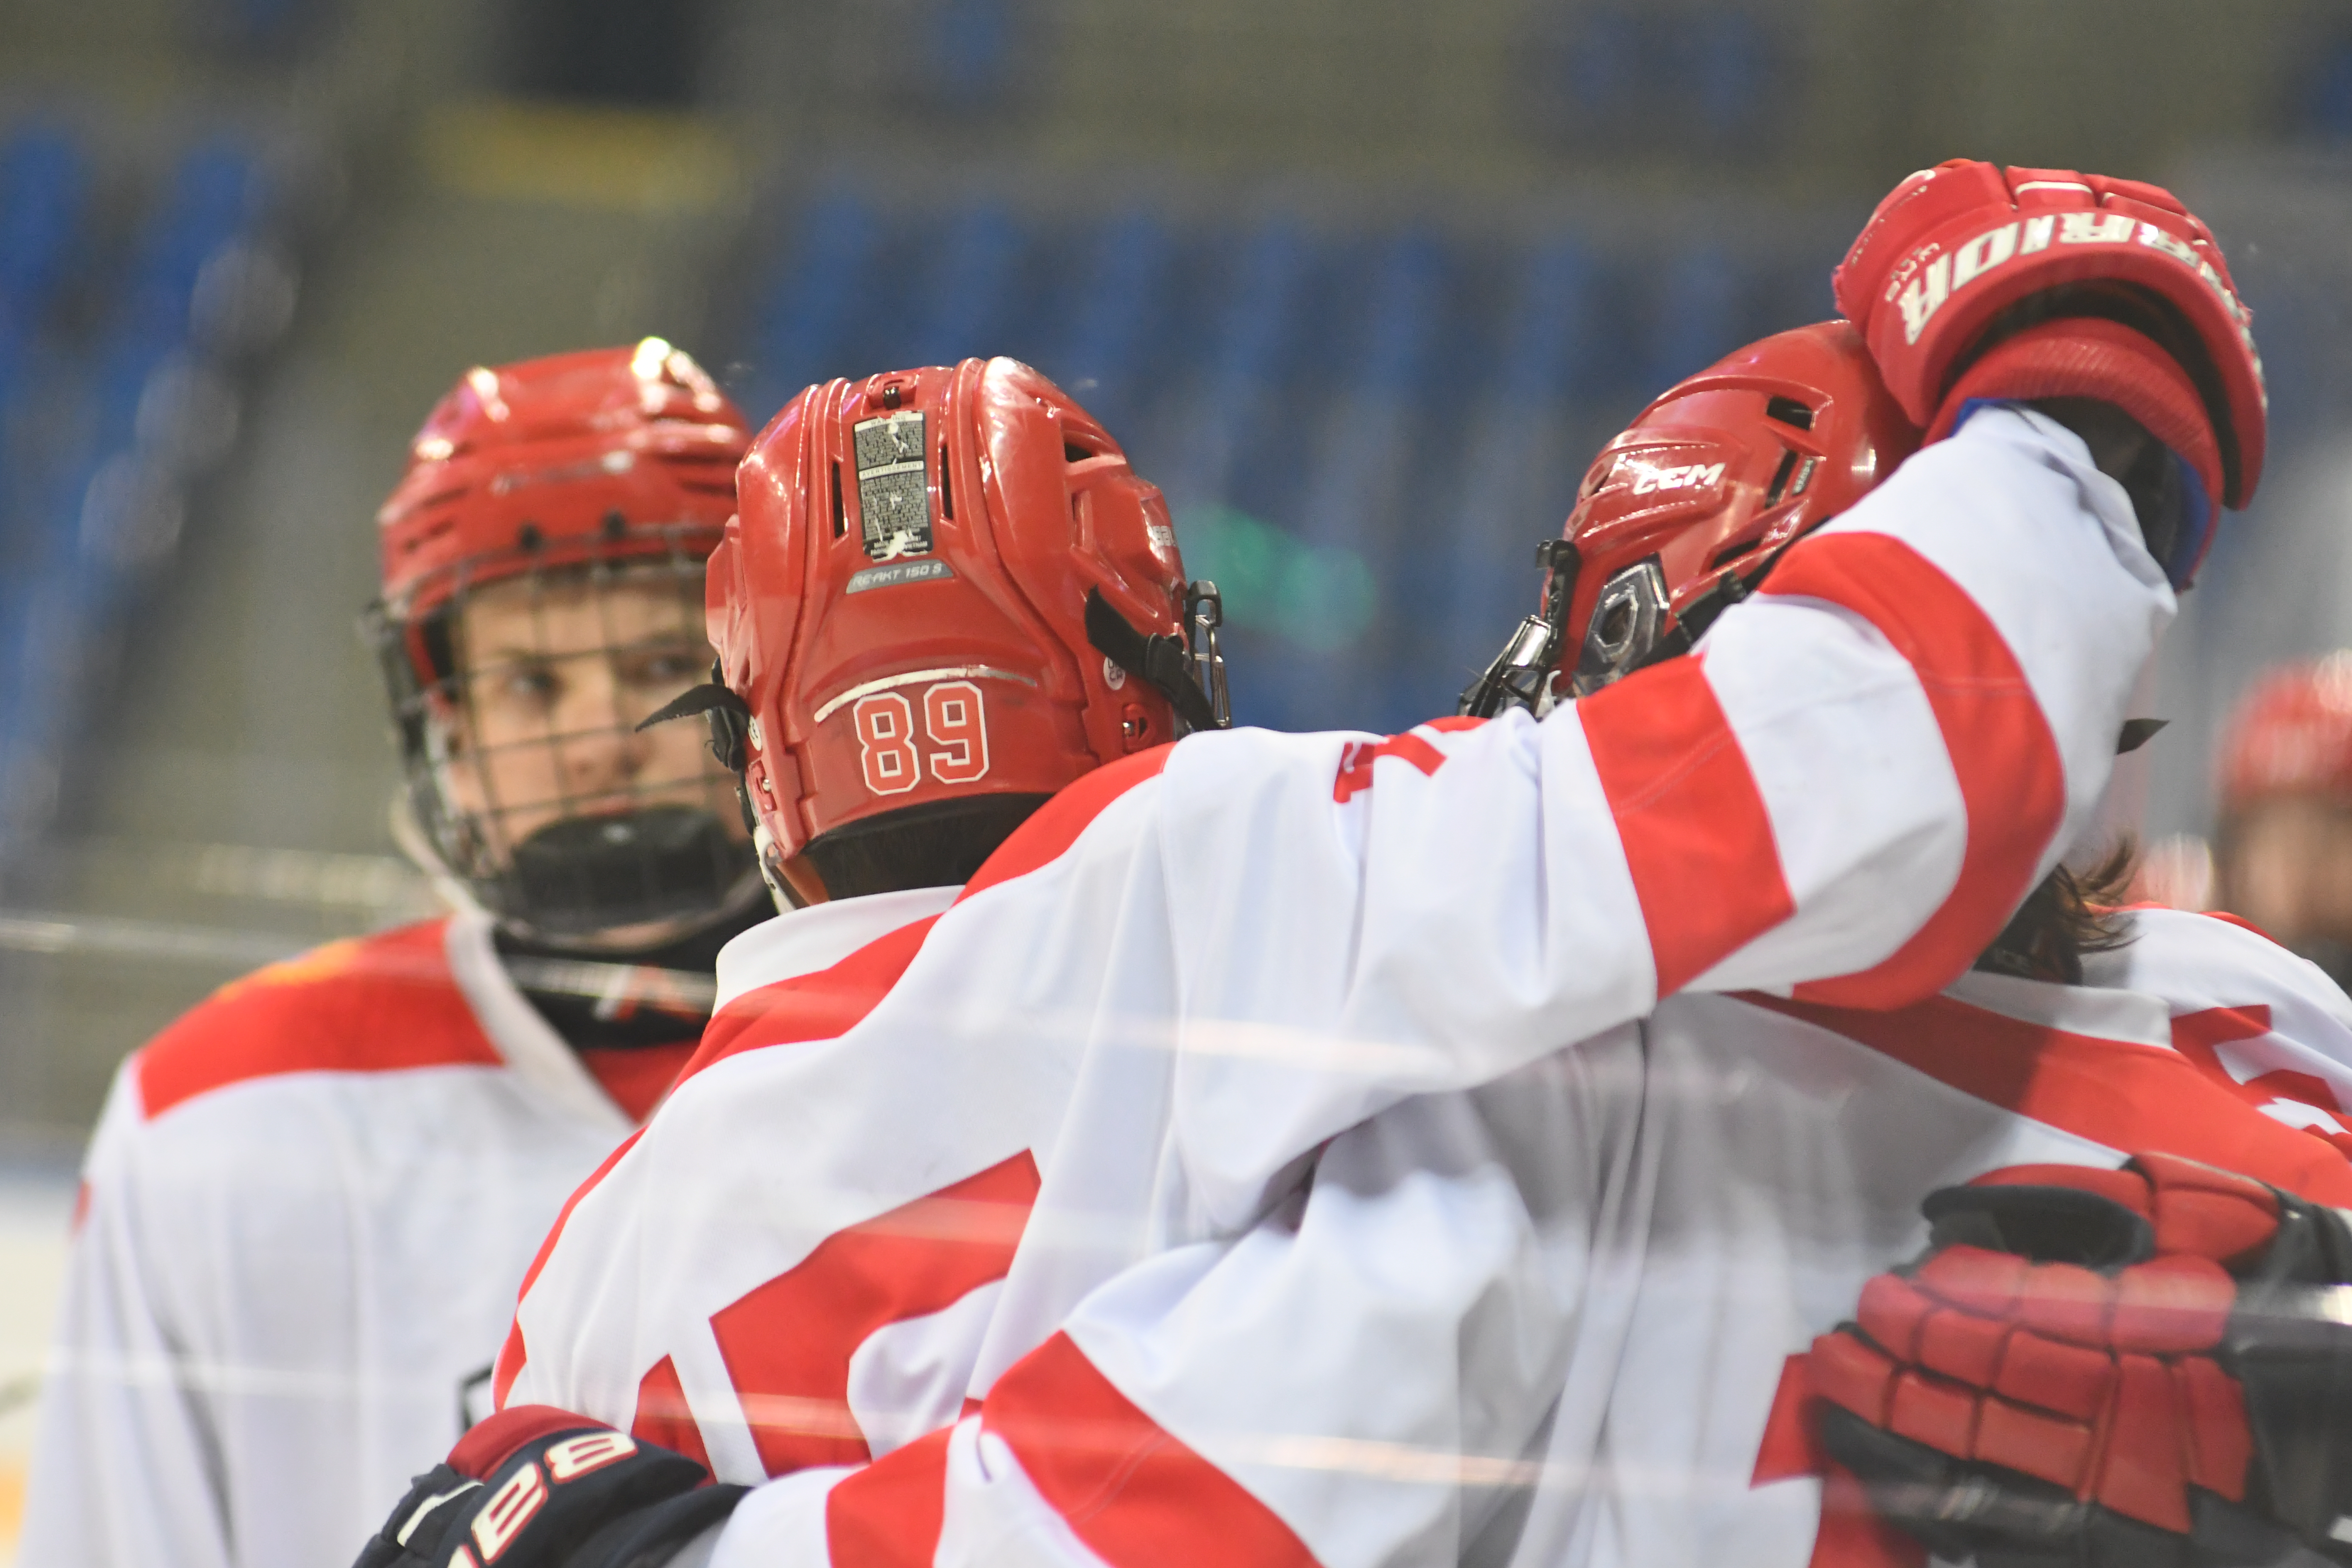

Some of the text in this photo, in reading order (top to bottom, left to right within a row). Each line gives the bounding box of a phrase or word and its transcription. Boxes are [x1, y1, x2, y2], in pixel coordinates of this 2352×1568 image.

[871, 415, 906, 425] WARING
[862, 463, 921, 476] AVERTISSEMENT
[1633, 463, 1726, 495] CCM
[906, 565, 930, 579] 150
[852, 680, 989, 796] 89
